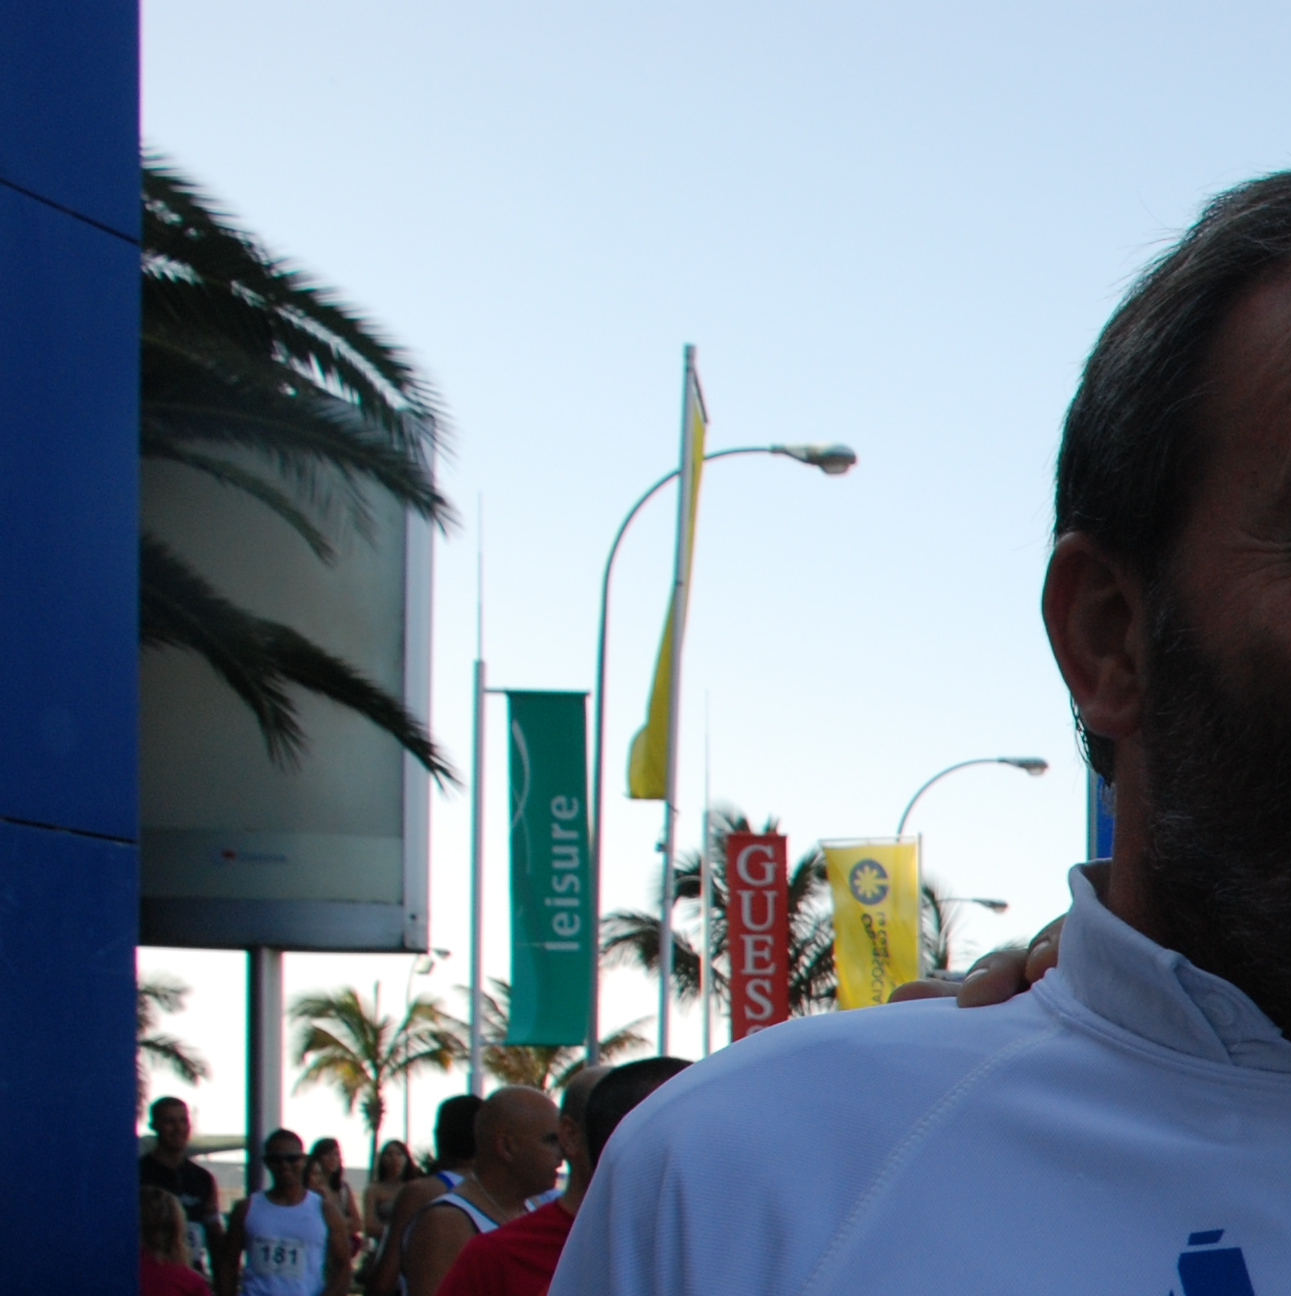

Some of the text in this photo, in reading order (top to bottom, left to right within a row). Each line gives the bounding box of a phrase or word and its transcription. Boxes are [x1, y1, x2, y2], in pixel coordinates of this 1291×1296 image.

[544, 794, 581, 952] leisure
[736, 843, 778, 1037] GUES
[261, 1244, 297, 1264] 181
